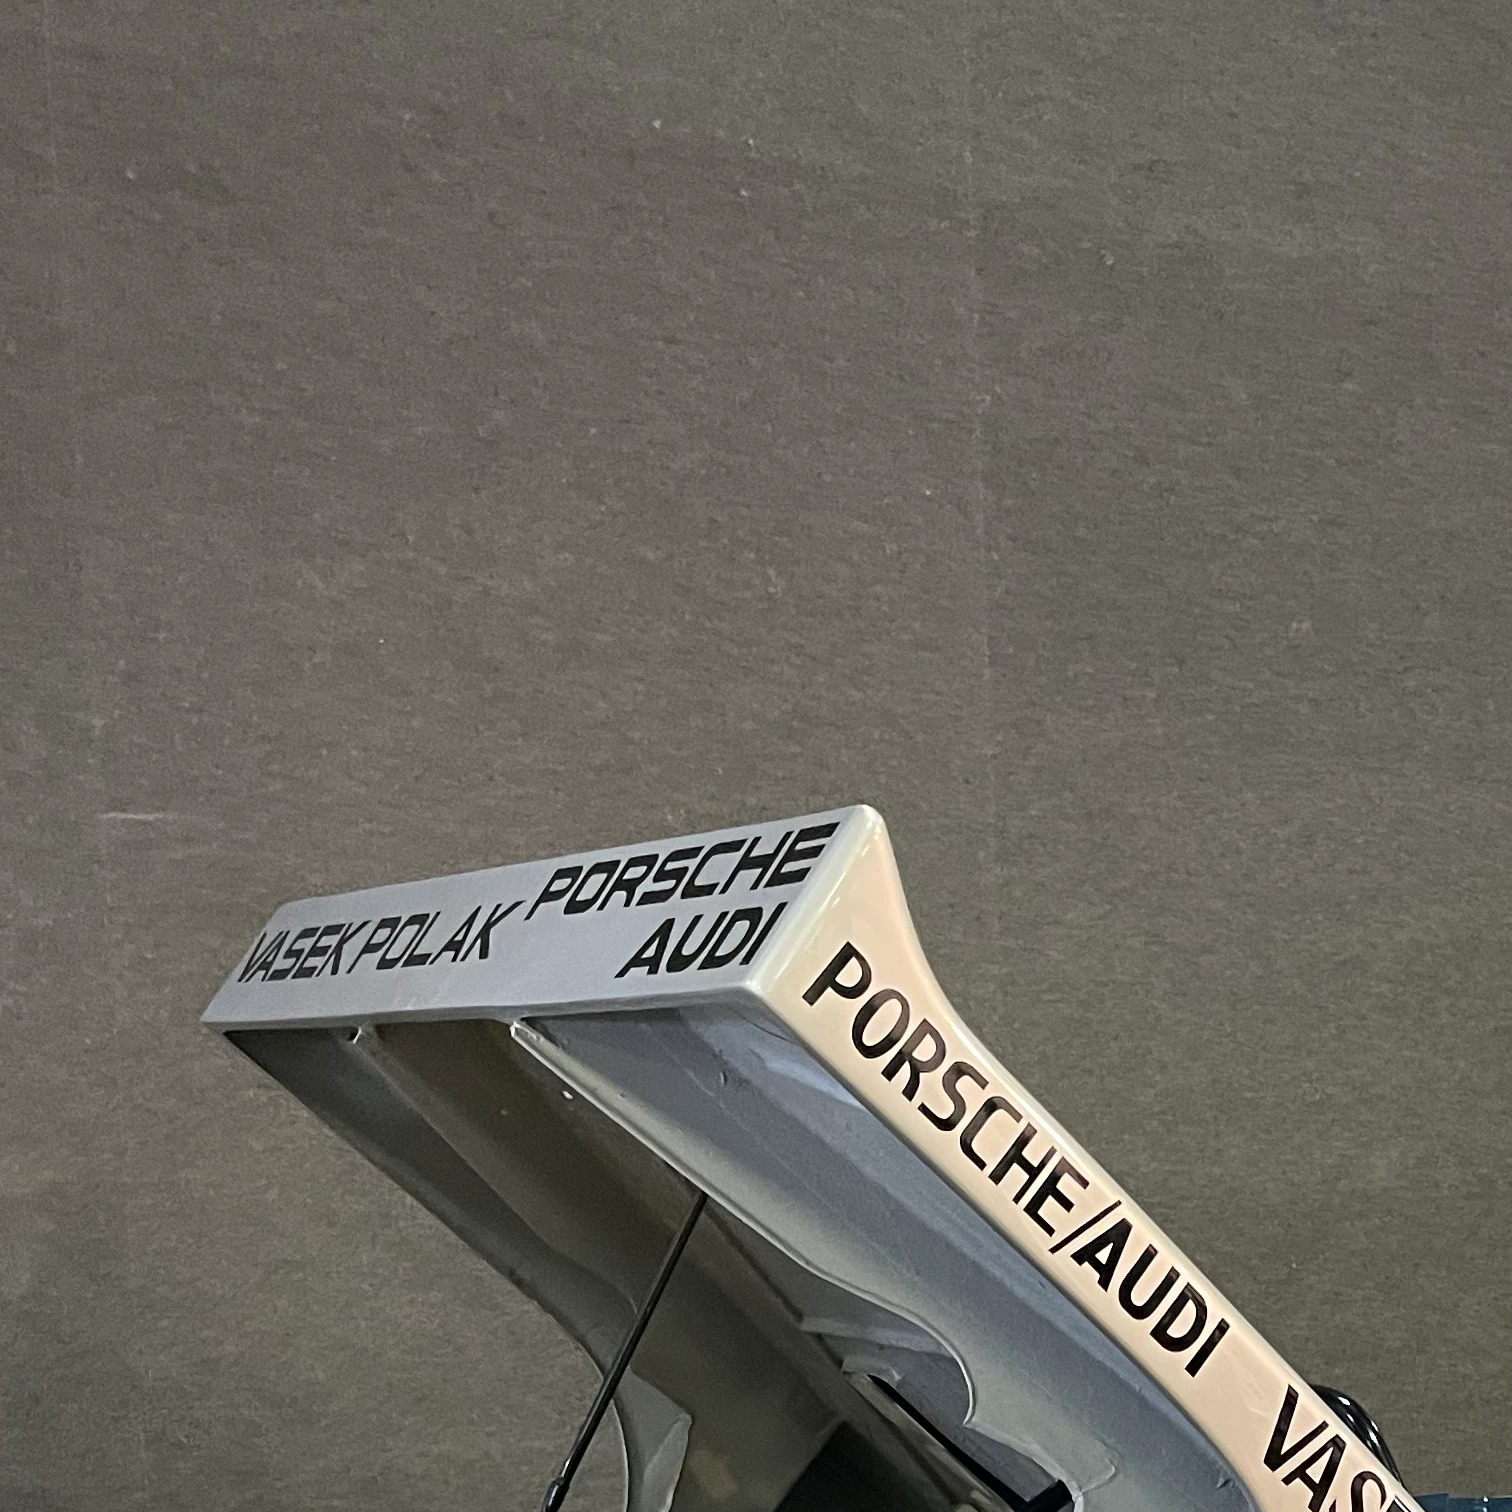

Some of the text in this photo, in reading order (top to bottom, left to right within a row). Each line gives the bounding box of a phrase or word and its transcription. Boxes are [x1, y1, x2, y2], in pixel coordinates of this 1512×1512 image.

[524, 821, 840, 921] PORSCHE
[237, 900, 527, 983] VASEK POLAK
[614, 901, 788, 979] AUDI
[802, 941, 1231, 1378] PORSCHE/AUDI
